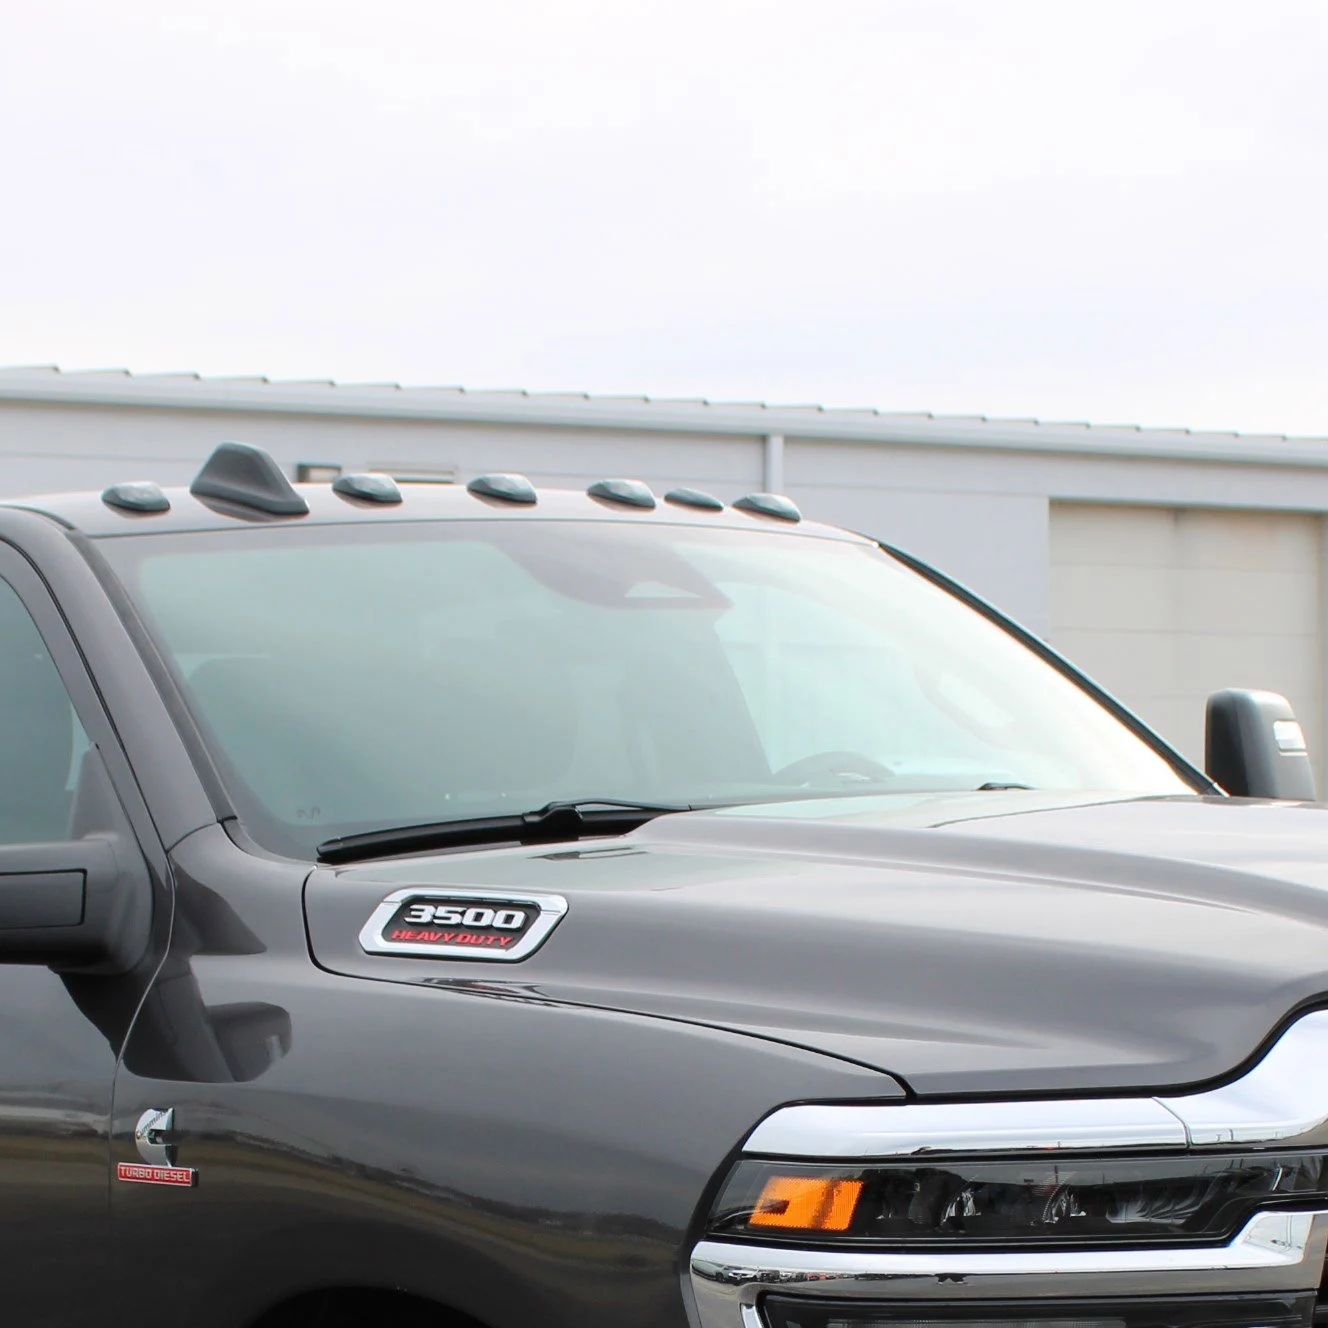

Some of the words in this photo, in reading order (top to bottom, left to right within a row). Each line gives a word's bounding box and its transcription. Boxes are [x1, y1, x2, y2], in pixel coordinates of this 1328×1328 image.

[403, 905, 527, 930] 3500
[391, 930, 455, 942] HEAVY
[457, 934, 513, 946] DUTY
[120, 1166, 152, 1179] TURBO
[154, 1168, 190, 1182] DIESEL
